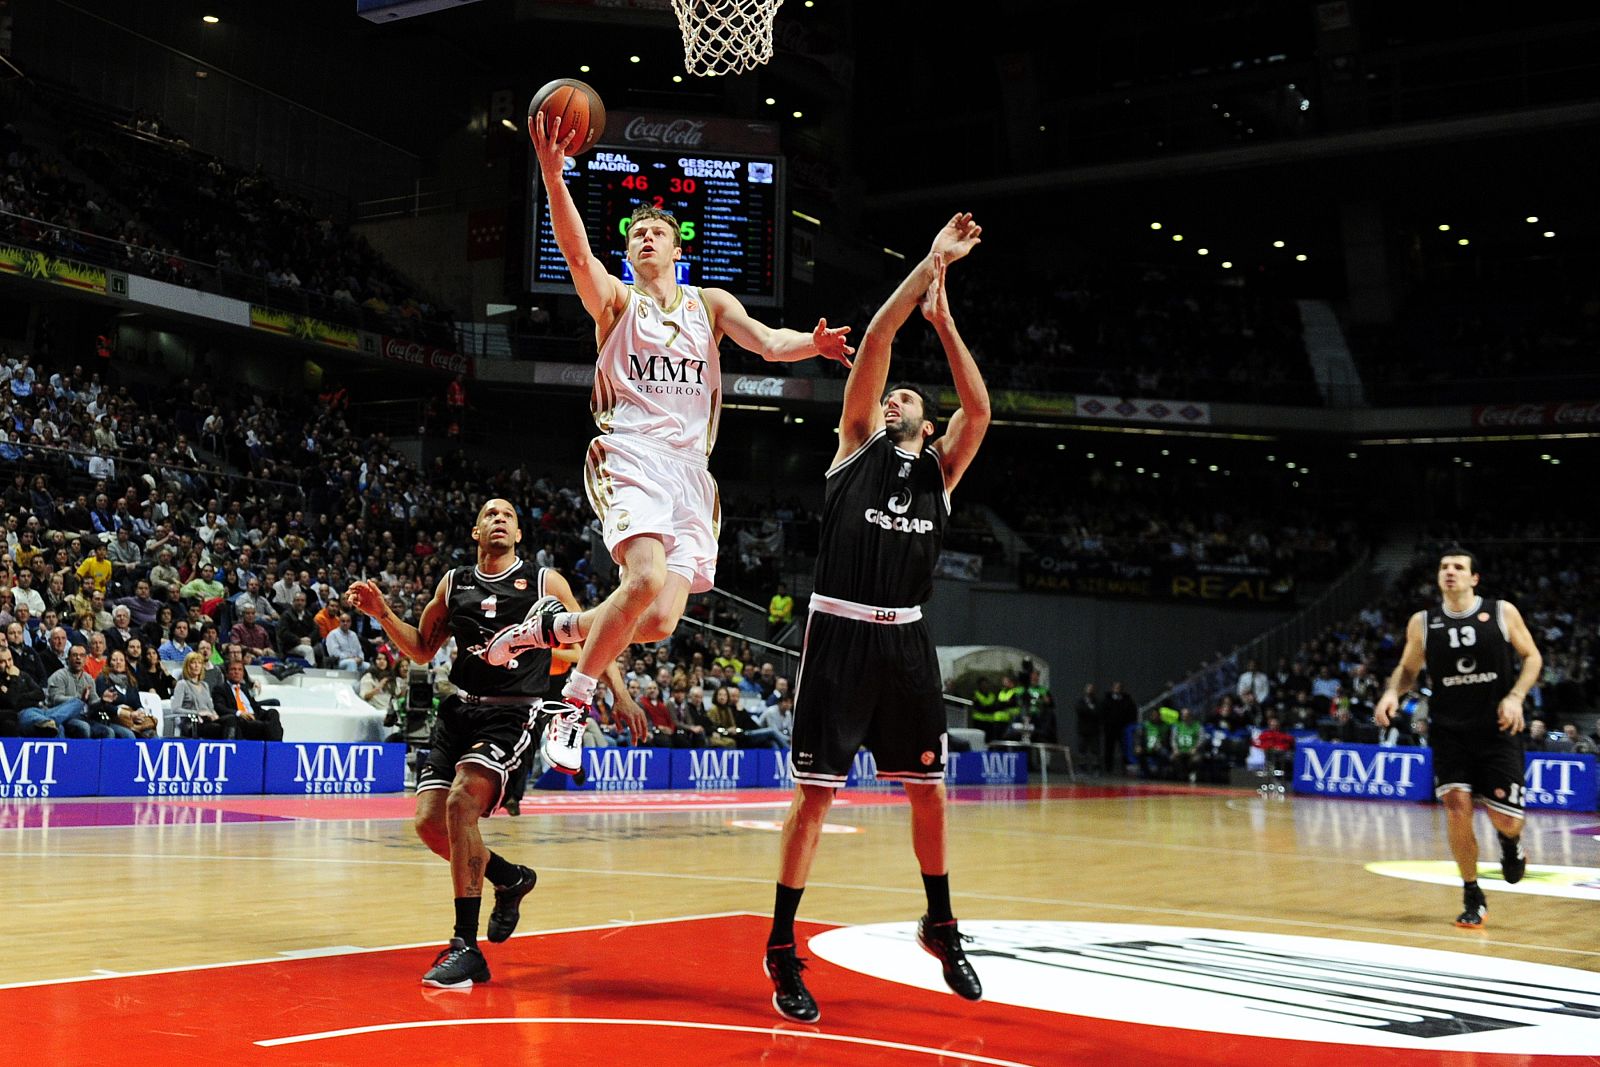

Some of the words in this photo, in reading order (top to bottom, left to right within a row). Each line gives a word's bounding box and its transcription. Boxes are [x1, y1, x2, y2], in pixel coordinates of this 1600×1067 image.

[588, 160, 640, 173] MADRID
[596, 152, 630, 164] REAL
[678, 157, 741, 170] GESCRAP
[684, 167, 736, 179] BIZKAIA
[621, 175, 648, 190] 46
[670, 178, 696, 193] 30
[652, 195, 664, 209] 2
[681, 221, 696, 241] 5
[662, 320, 681, 348] 7
[627, 354, 708, 385] MMT
[637, 384, 701, 396] SEGUROS
[1171, 576, 1281, 603] REAL
[1447, 625, 1476, 648] 13
[0, 741, 67, 784] MT
[134, 742, 236, 783] MMT
[293, 744, 383, 782] MMT
[587, 749, 653, 782] MMT
[688, 749, 745, 781] MMT
[981, 752, 1019, 778] MMT
[1299, 747, 1426, 788] MMT
[0, 784, 49, 797] UROS
[147, 782, 223, 795] SEGUROS
[305, 781, 371, 793] SEGUROS
[1314, 780, 1407, 797] SEGUROS
